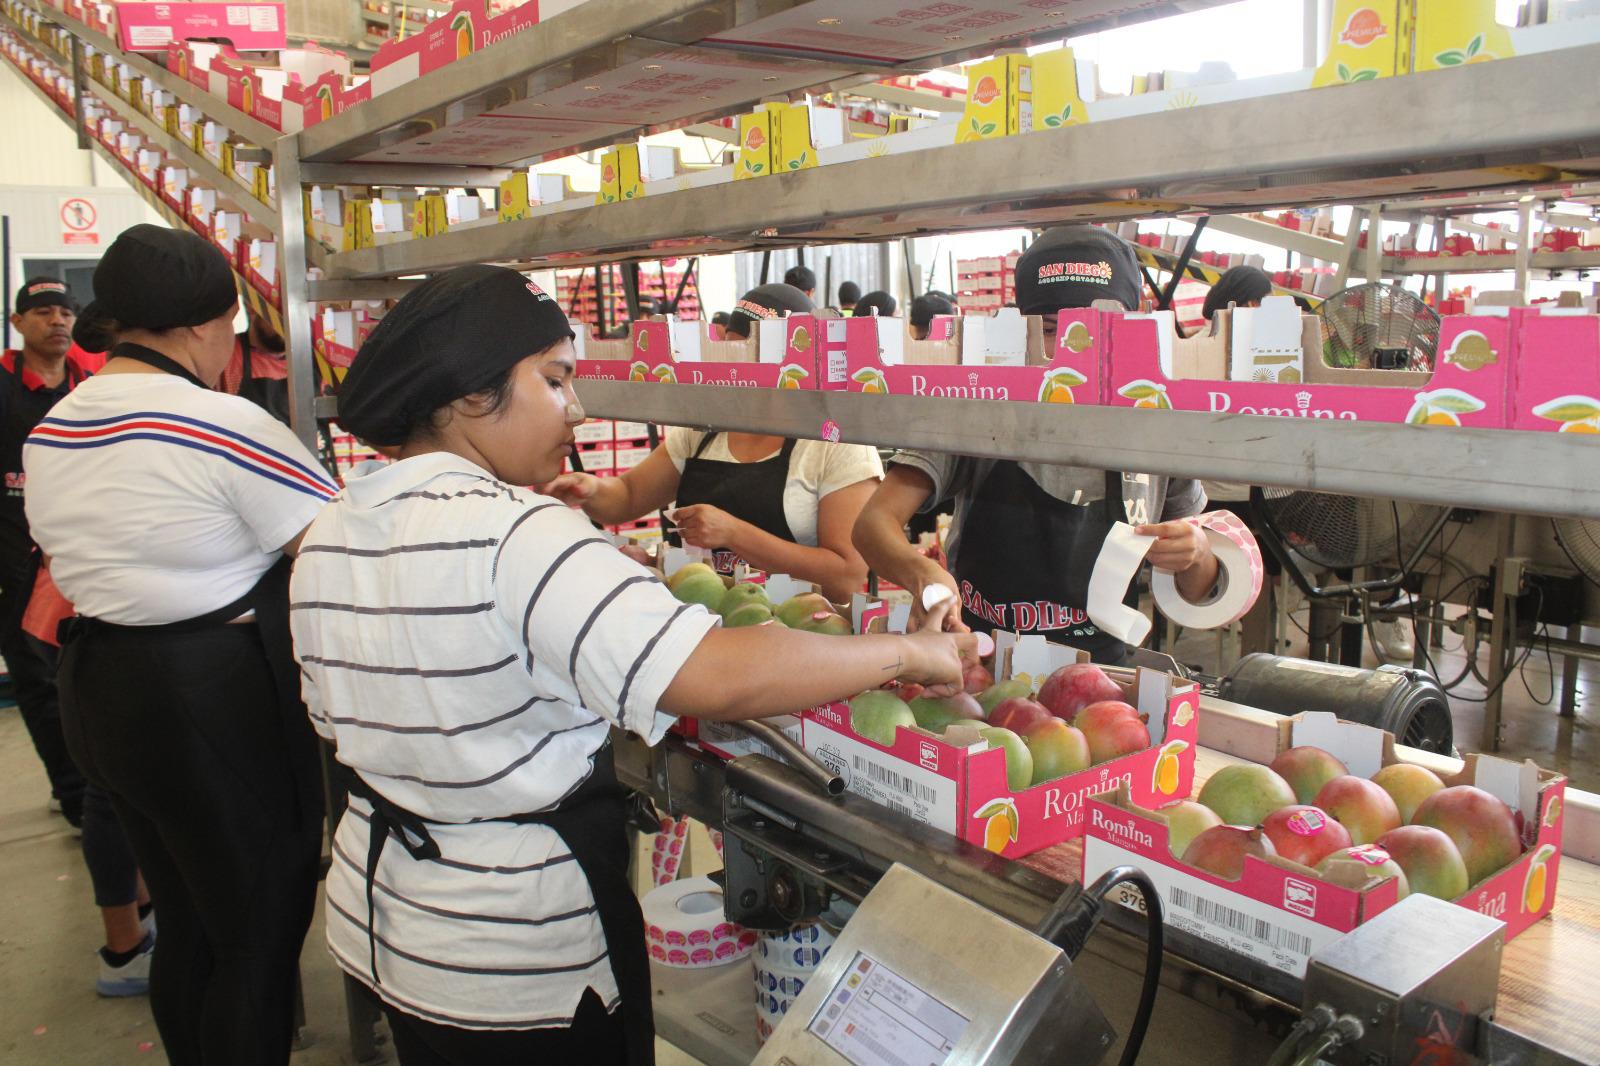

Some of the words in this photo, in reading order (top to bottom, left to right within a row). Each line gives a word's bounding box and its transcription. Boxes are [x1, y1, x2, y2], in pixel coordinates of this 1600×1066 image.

[1038, 263, 1065, 278] SAN
[1065, 261, 1109, 279] DIEGO
[911, 375, 1009, 401] Romina
[961, 579, 1006, 627] SAN
[1011, 600, 1088, 631] DIEG
[1092, 808, 1153, 848] Romina
[1120, 890, 1148, 911] 376
